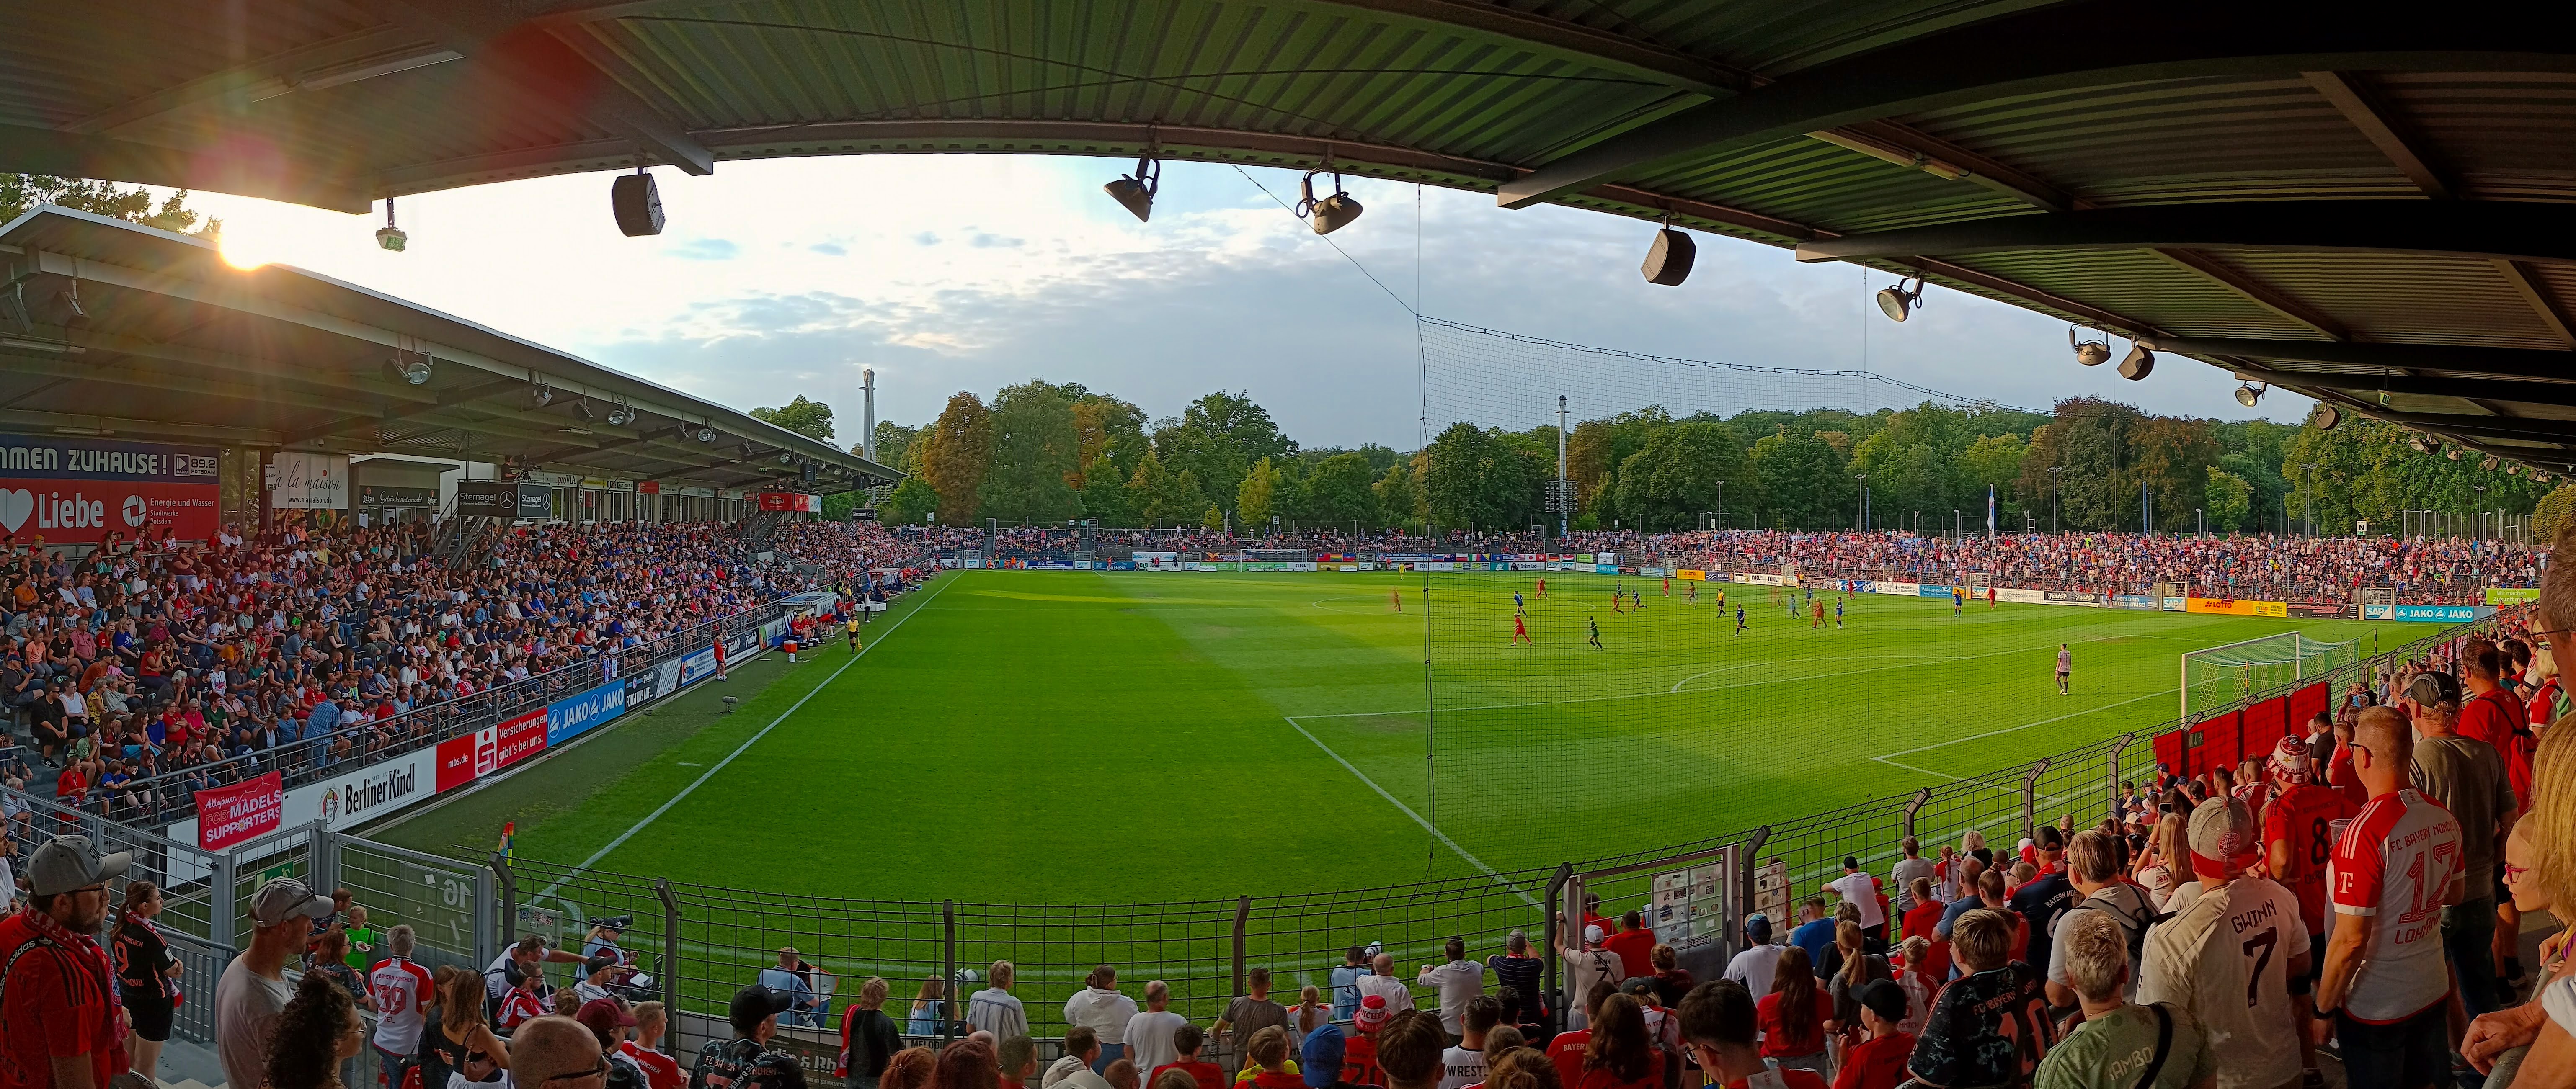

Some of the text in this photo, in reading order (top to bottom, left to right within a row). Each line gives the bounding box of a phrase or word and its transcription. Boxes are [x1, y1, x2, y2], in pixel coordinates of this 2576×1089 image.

[191, 459, 215, 469] 89.2
[288, 460, 302, 488] la
[304, 478, 341, 490] maison
[558, 475, 576, 485] proVIA
[150, 498, 176, 508] Energie
[460, 493, 496, 502] Sternagel
[522, 494, 541, 502] Sternagel
[39, 492, 104, 528] Liebe
[2164, 599, 2179, 608] SAP
[2367, 608, 2385, 616] SAP
[601, 687, 625, 713] JAKO
[626, 692, 637, 708] FOLGT
[563, 702, 588, 729] JAKO
[499, 713, 547, 740] Versicherungen
[519, 737, 529, 751] bei
[530, 734, 543, 747] uns.
[448, 753, 469, 769] mbs.de
[345, 762, 416, 817] Berliner Kindl
[204, 796, 237, 811] Allgäuer
[205, 809, 229, 827] FCB
[2310, 816, 2329, 866] 8
[2390, 839, 2403, 854] FC
[2404, 828, 2431, 847] BAYERN
[2045, 890, 2066, 908] BAYERN
[2230, 898, 2277, 935] GWINN
[9, 940, 36, 967] adidas
[114, 940, 129, 974] 9
[2243, 926, 2278, 1009] 7
[377, 984, 407, 1015] 39
[1986, 990, 2016, 1010] BAYERN
[1361, 1009, 1386, 1020] NCHEN
[911, 1040, 944, 1050] MELODI
[637, 1058, 661, 1074] MÜNCHEN
[705, 1055, 713, 1064] FC
[800, 1056, 810, 1068] &
[814, 1077, 847, 1088] GEGENKULTU
